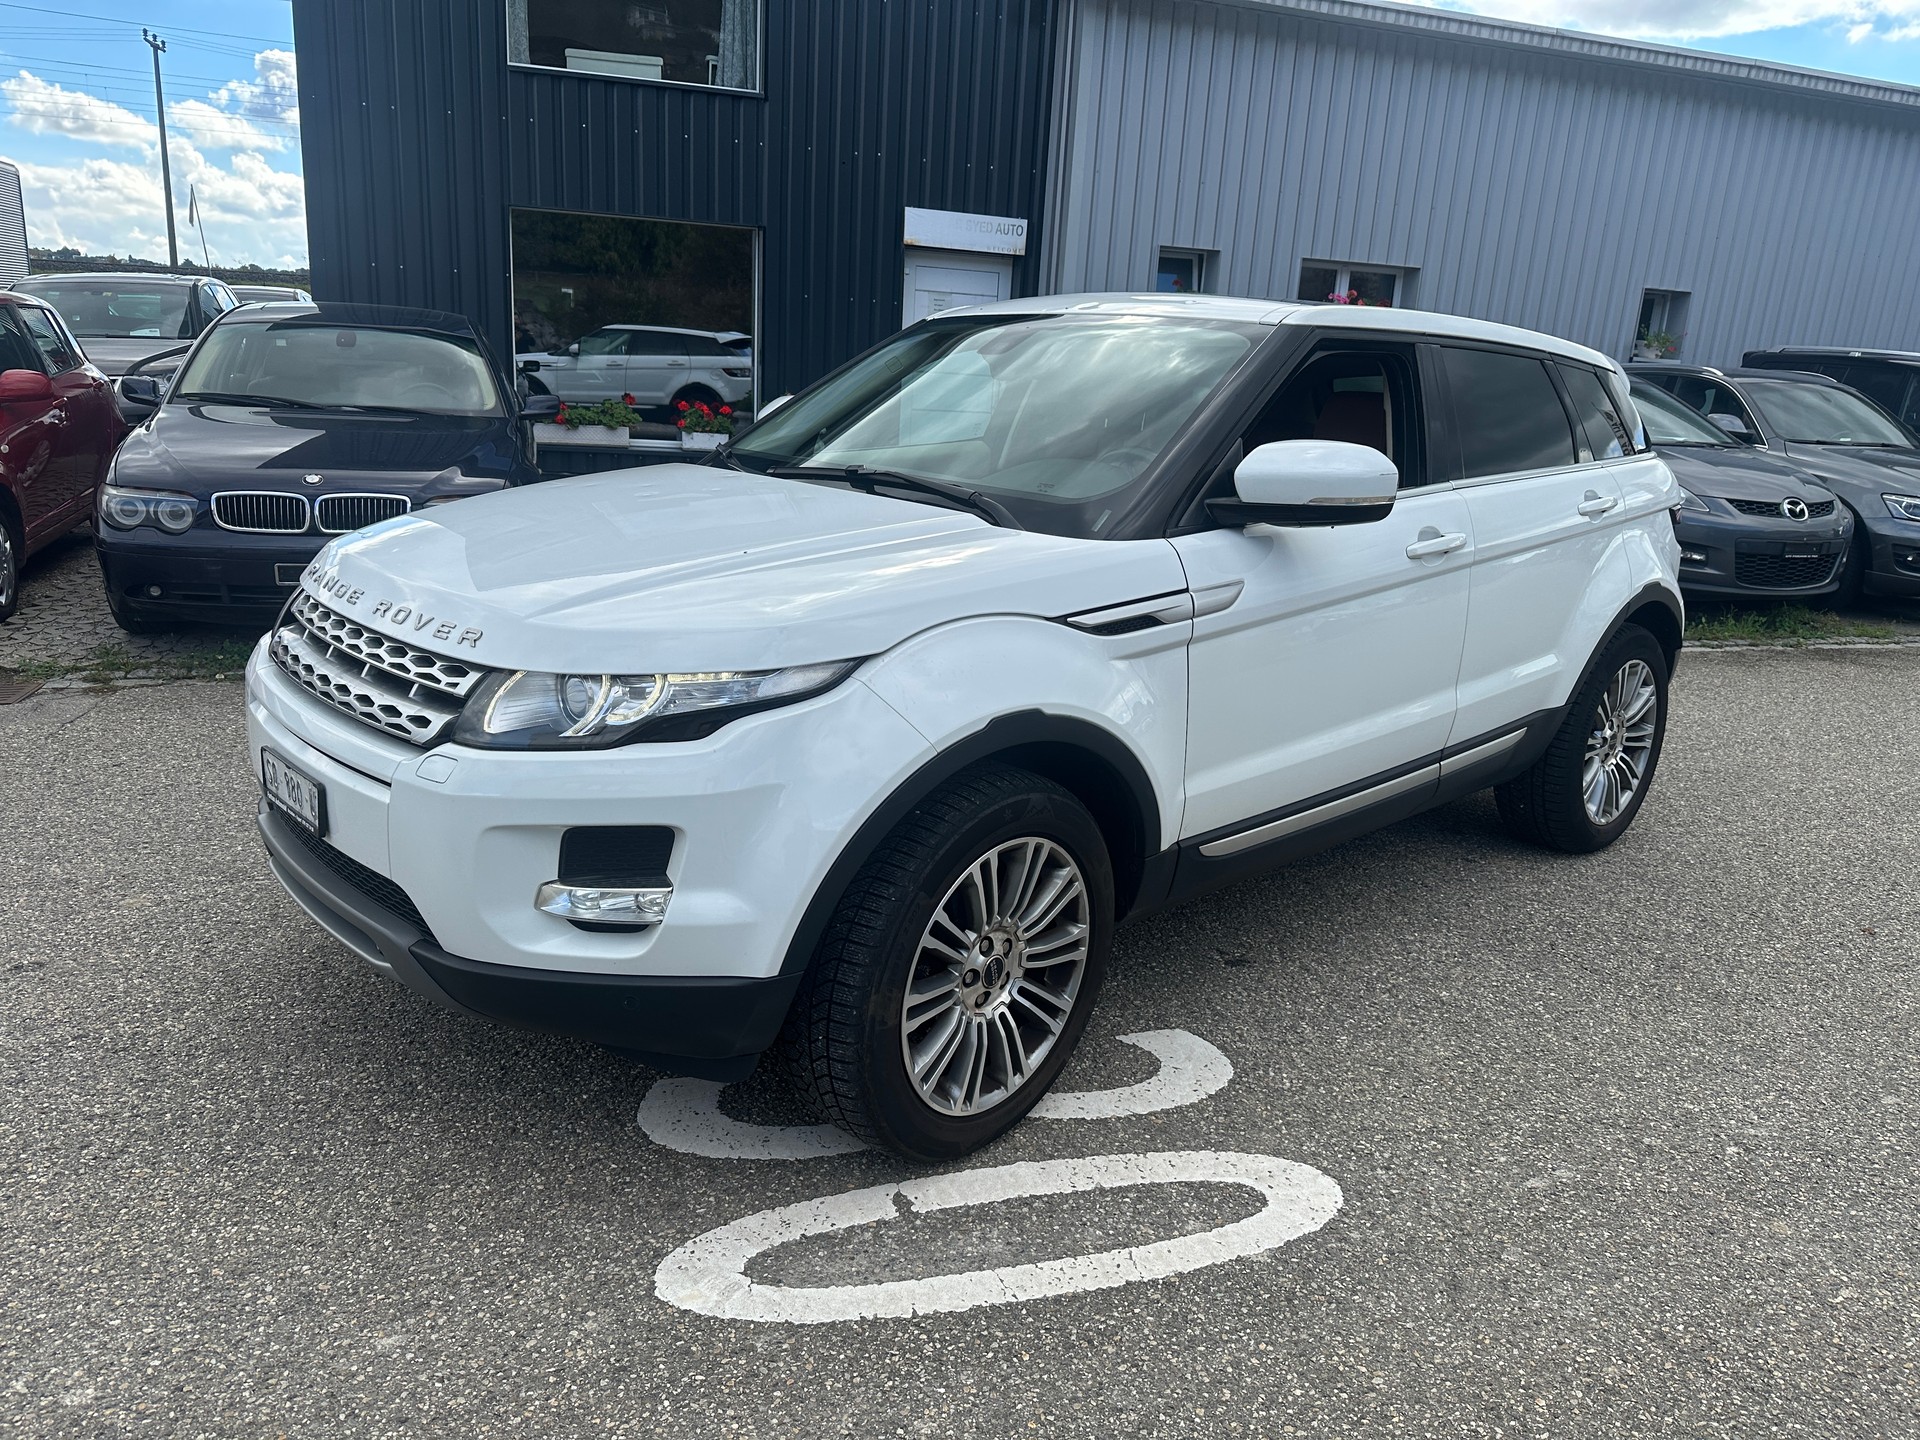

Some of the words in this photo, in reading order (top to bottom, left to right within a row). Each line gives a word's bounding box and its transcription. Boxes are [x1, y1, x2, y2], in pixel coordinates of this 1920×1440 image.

[995, 223, 1024, 237] AUTO
[307, 562, 365, 605] RANGE
[372, 598, 484, 648] ROVER
